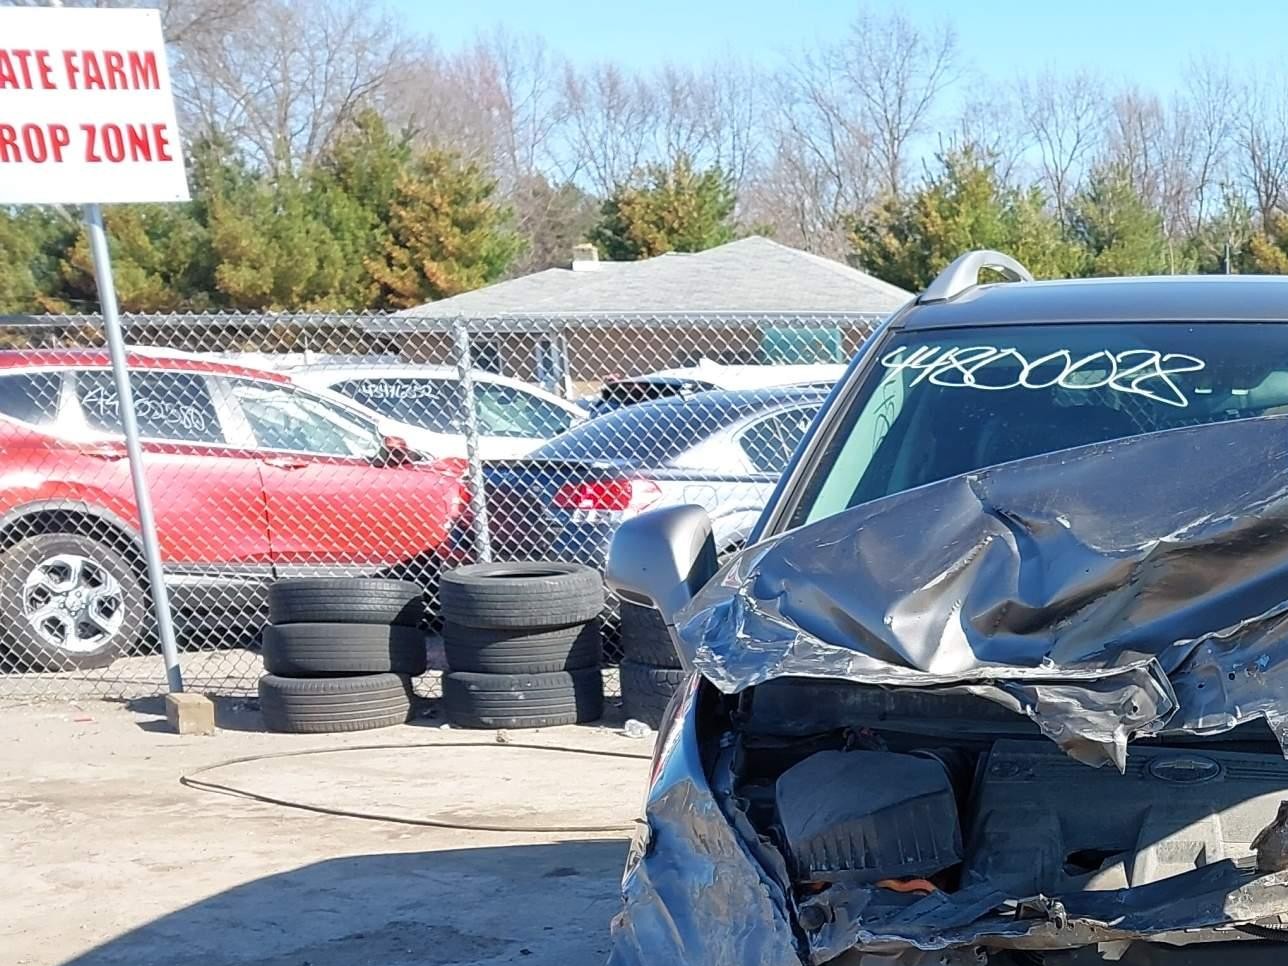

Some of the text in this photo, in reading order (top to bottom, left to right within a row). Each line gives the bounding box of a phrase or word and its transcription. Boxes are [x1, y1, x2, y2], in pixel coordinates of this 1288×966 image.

[62, 50, 160, 90] FARM
[79, 122, 173, 163] ZONE
[882, 346, 1206, 406] 44800028
